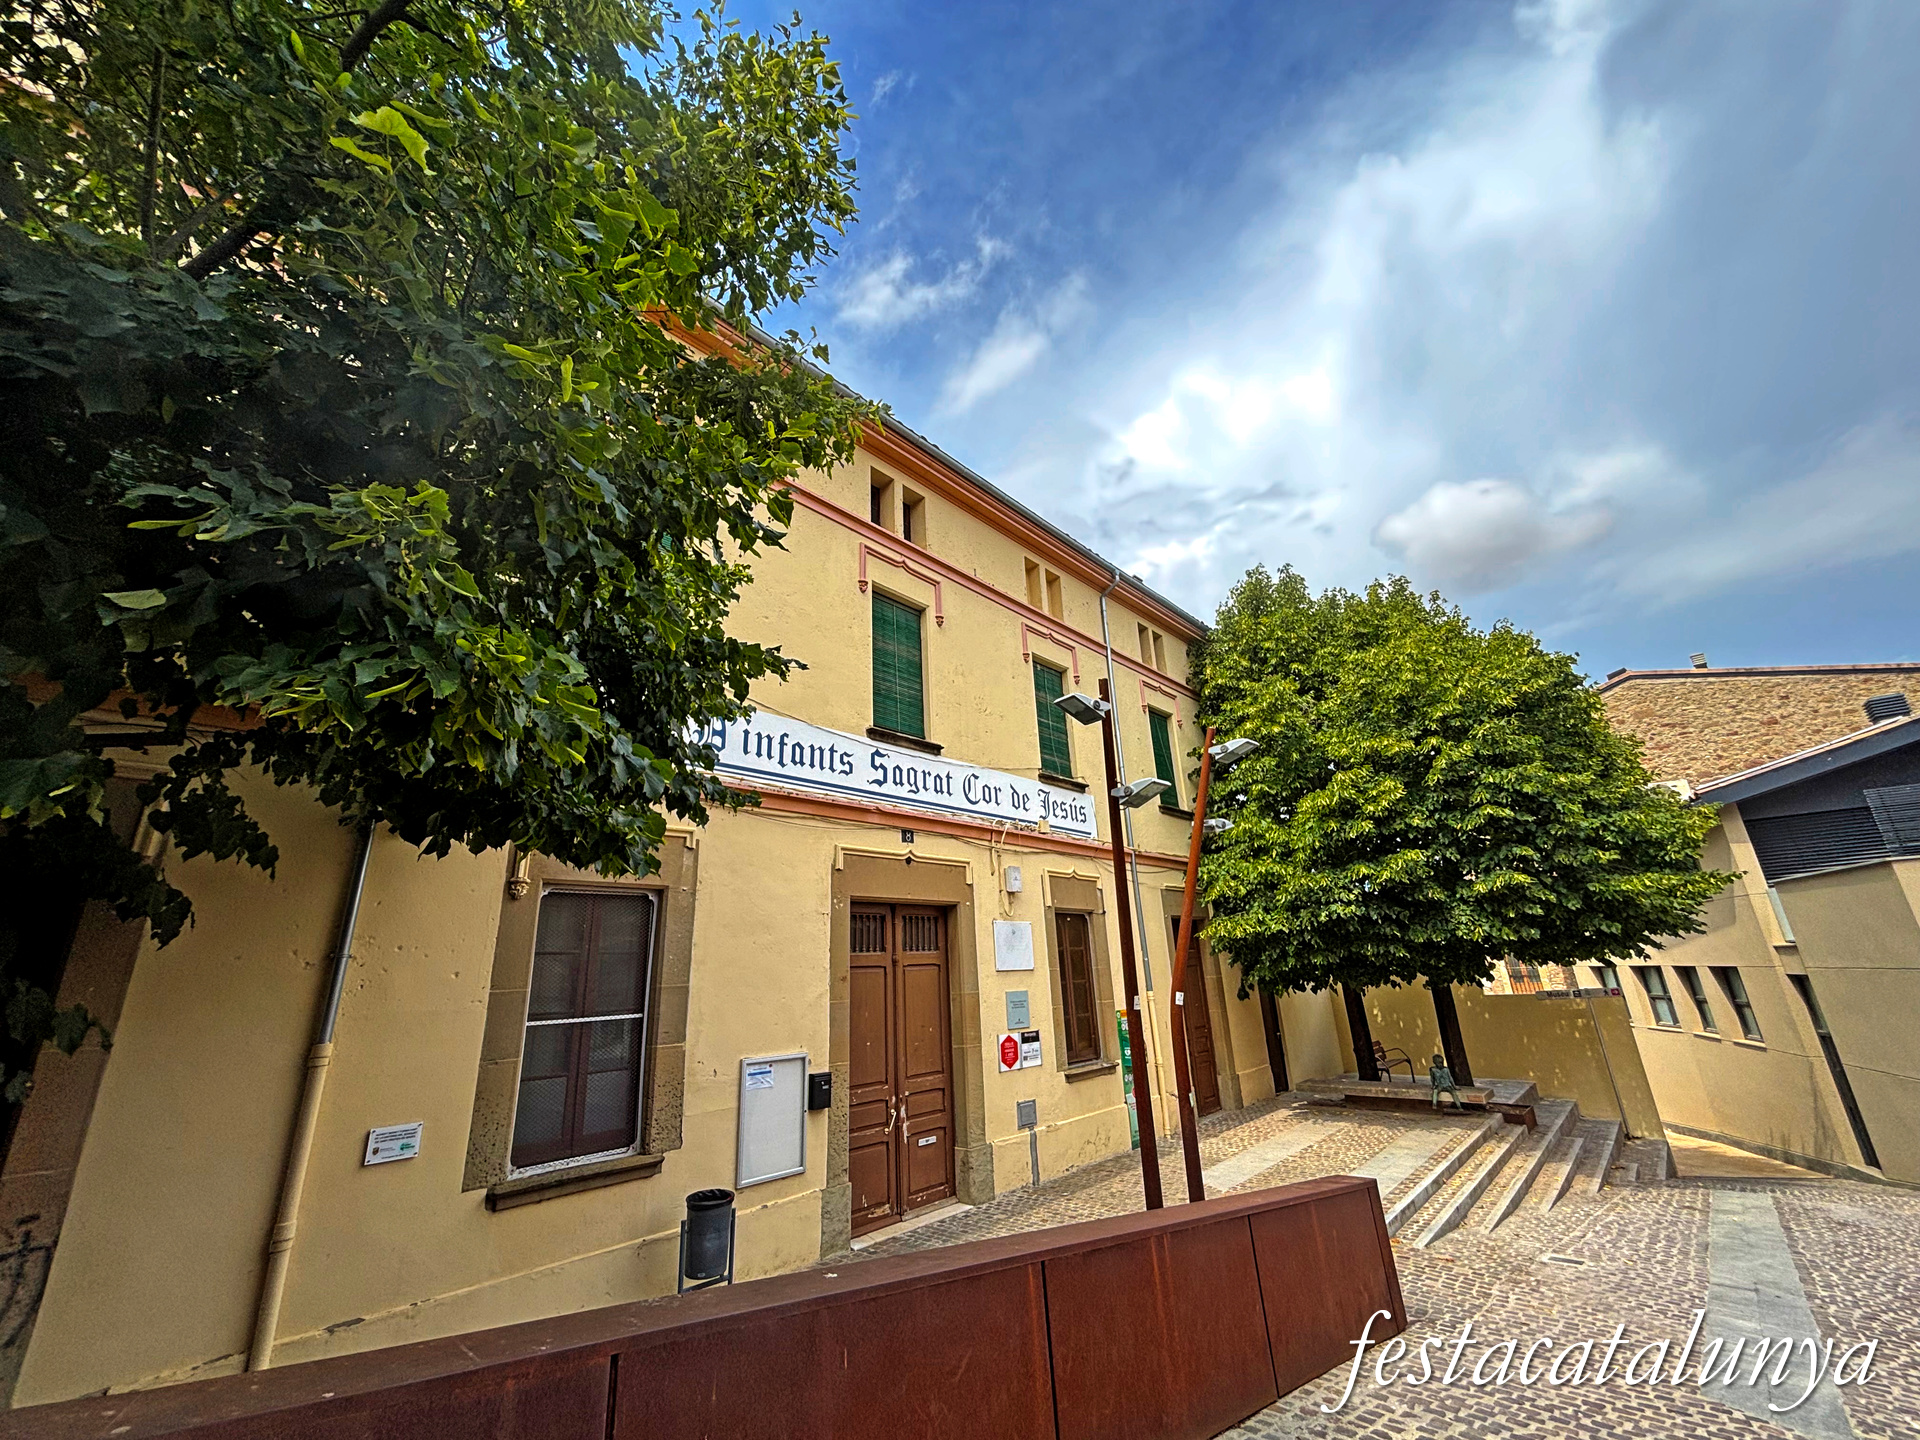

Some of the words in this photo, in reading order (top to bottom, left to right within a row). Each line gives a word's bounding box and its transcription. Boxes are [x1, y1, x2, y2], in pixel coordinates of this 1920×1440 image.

[867, 748, 953, 796] Sagrat
[963, 773, 1002, 806] Cor
[1010, 783, 1031, 812] de
[1037, 788, 1088, 824] Jesús
